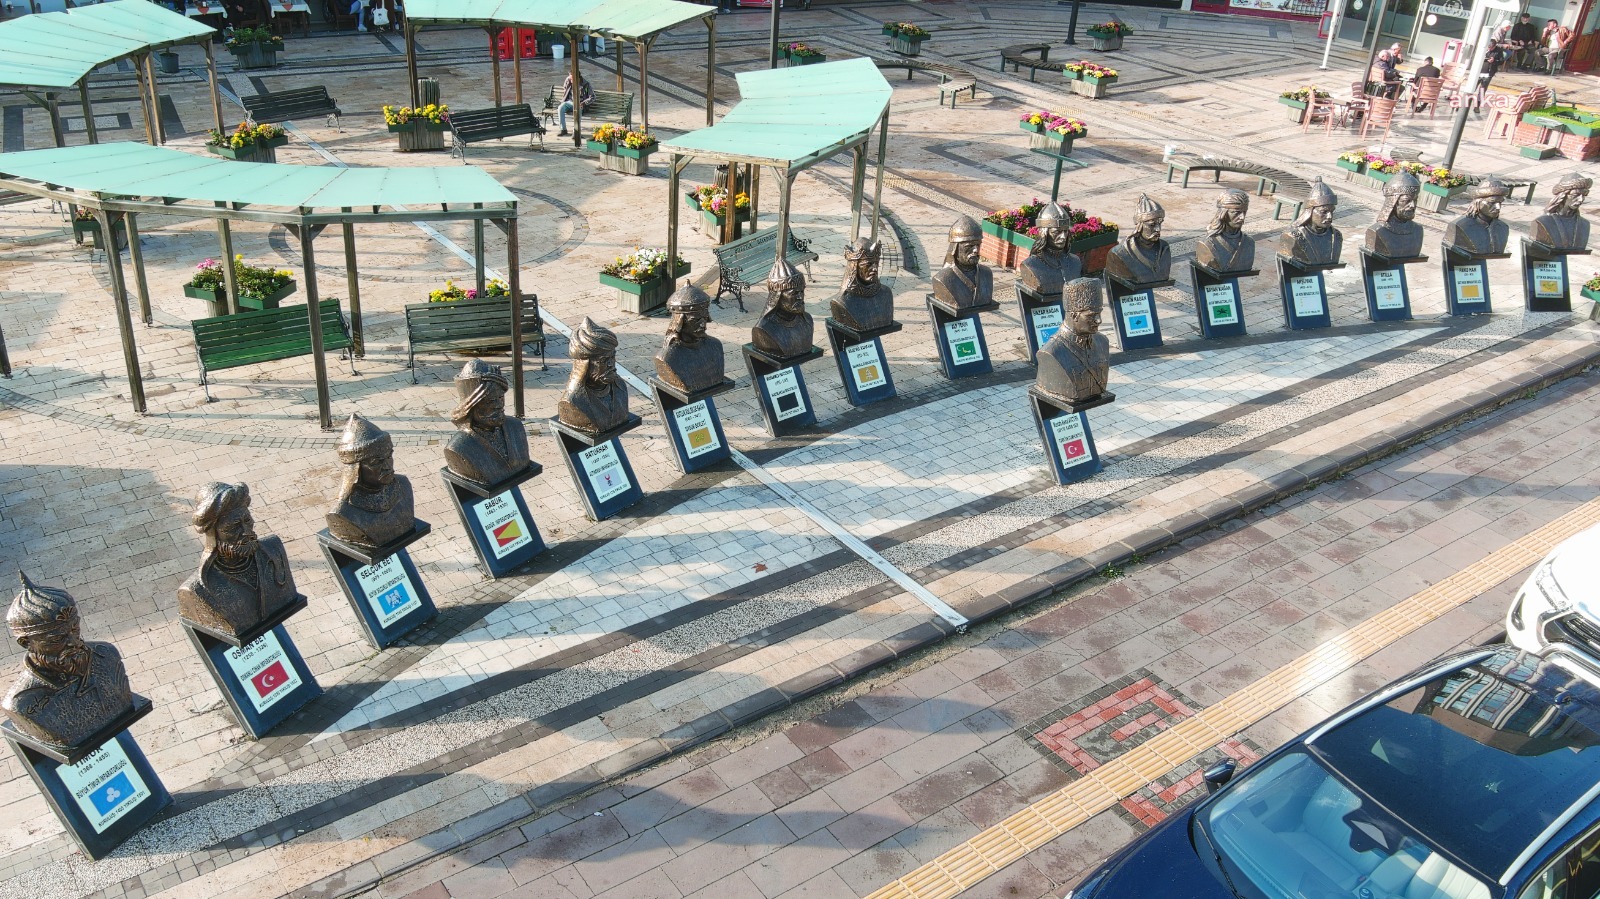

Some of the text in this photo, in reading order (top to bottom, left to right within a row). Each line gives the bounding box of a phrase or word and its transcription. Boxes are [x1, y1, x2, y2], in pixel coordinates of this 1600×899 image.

[485, 497, 502, 509] BABÜR
[361, 557, 393, 579] SELÇUK BEY
[232, 643, 254, 659] OSMAN
